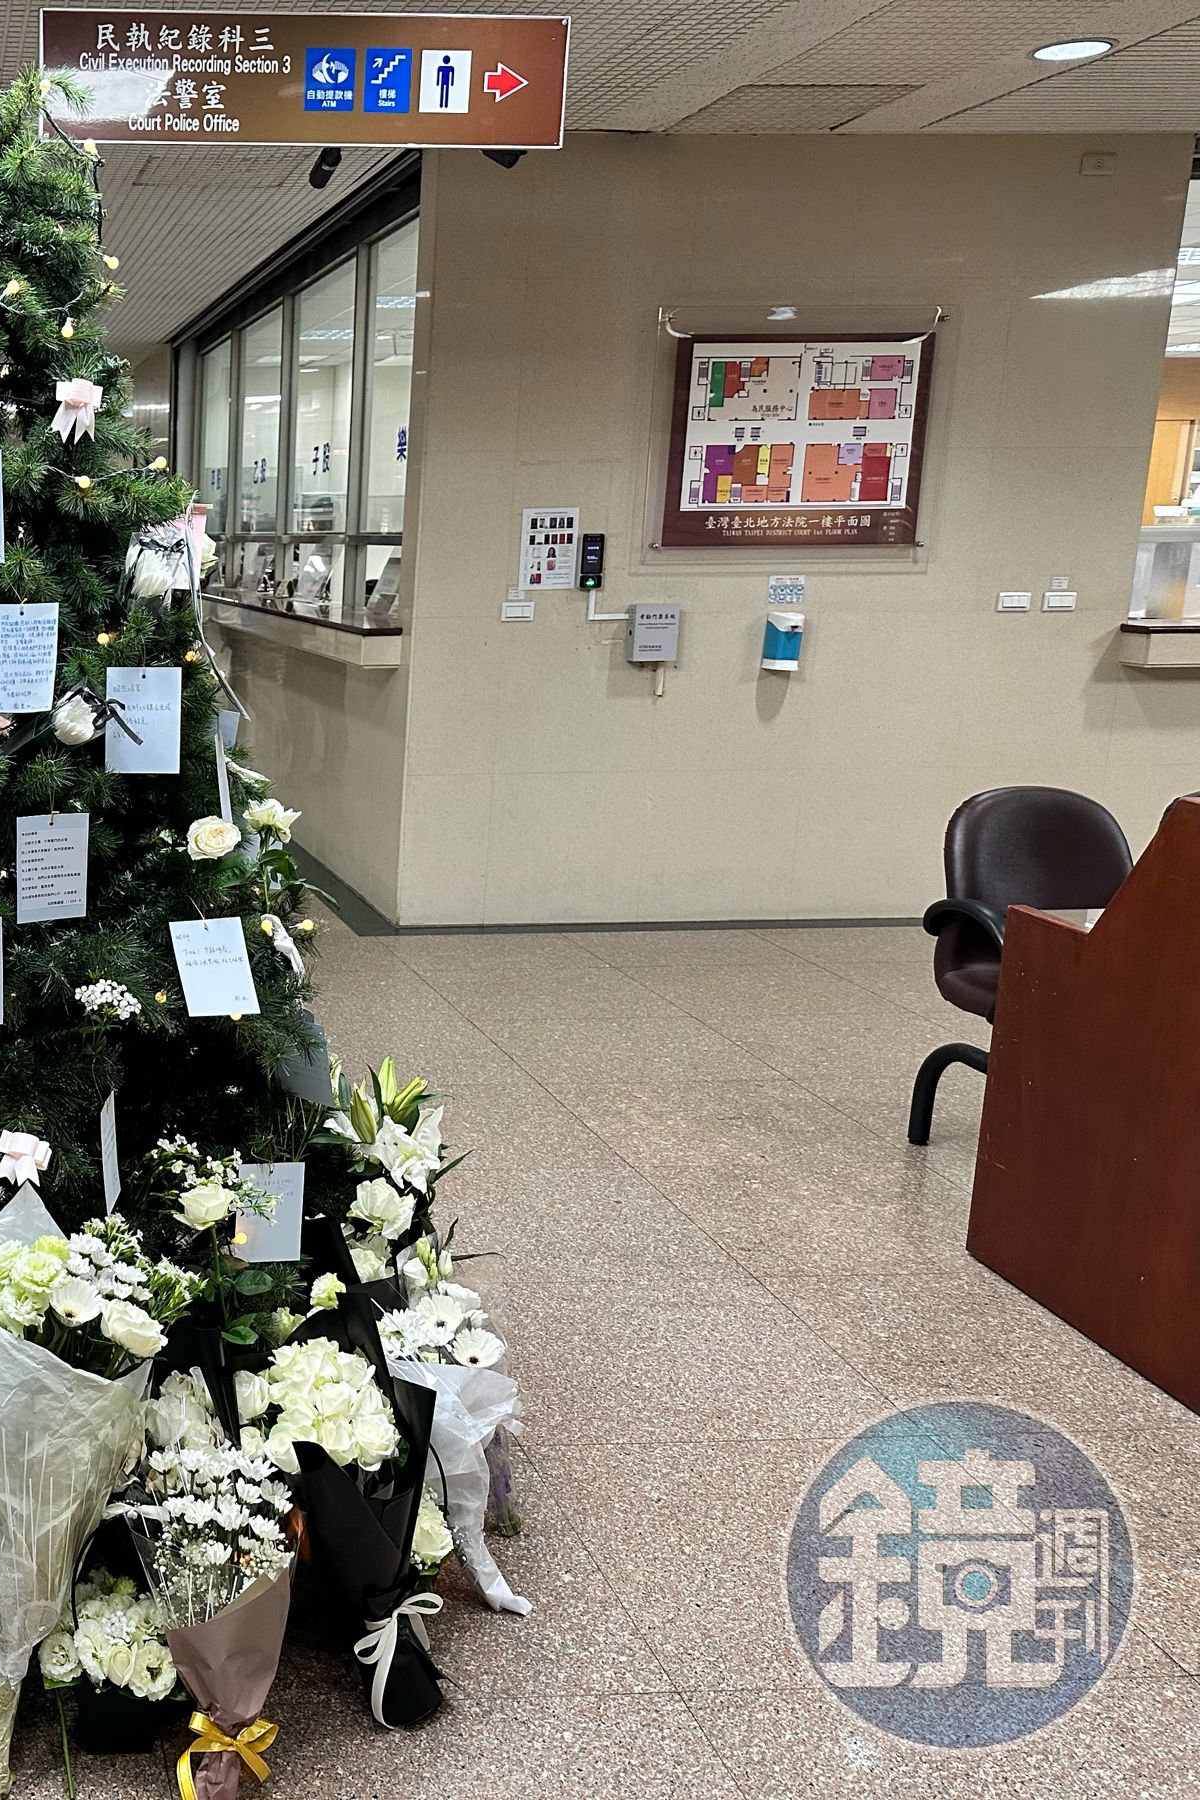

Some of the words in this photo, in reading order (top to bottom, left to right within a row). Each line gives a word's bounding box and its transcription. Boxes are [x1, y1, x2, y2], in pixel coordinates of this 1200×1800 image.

[96, 22, 275, 54] 民執紀錄科三
[79, 52, 105, 71] Civil
[109, 53, 170, 72] Execution
[172, 53, 231, 75] Recording
[235, 55, 279, 74] Section
[282, 55, 291, 74] 3
[306, 89, 353, 101] 自動提款機
[378, 88, 397, 100] 樓梯
[321, 100, 337, 108] ATM
[377, 99, 396, 108] Stairs
[128, 113, 162, 131] Court
[164, 113, 200, 132] Police
[202, 113, 240, 132] Office
[704, 514, 871, 530] 臺灣臺北地方法院一樓平面圖
